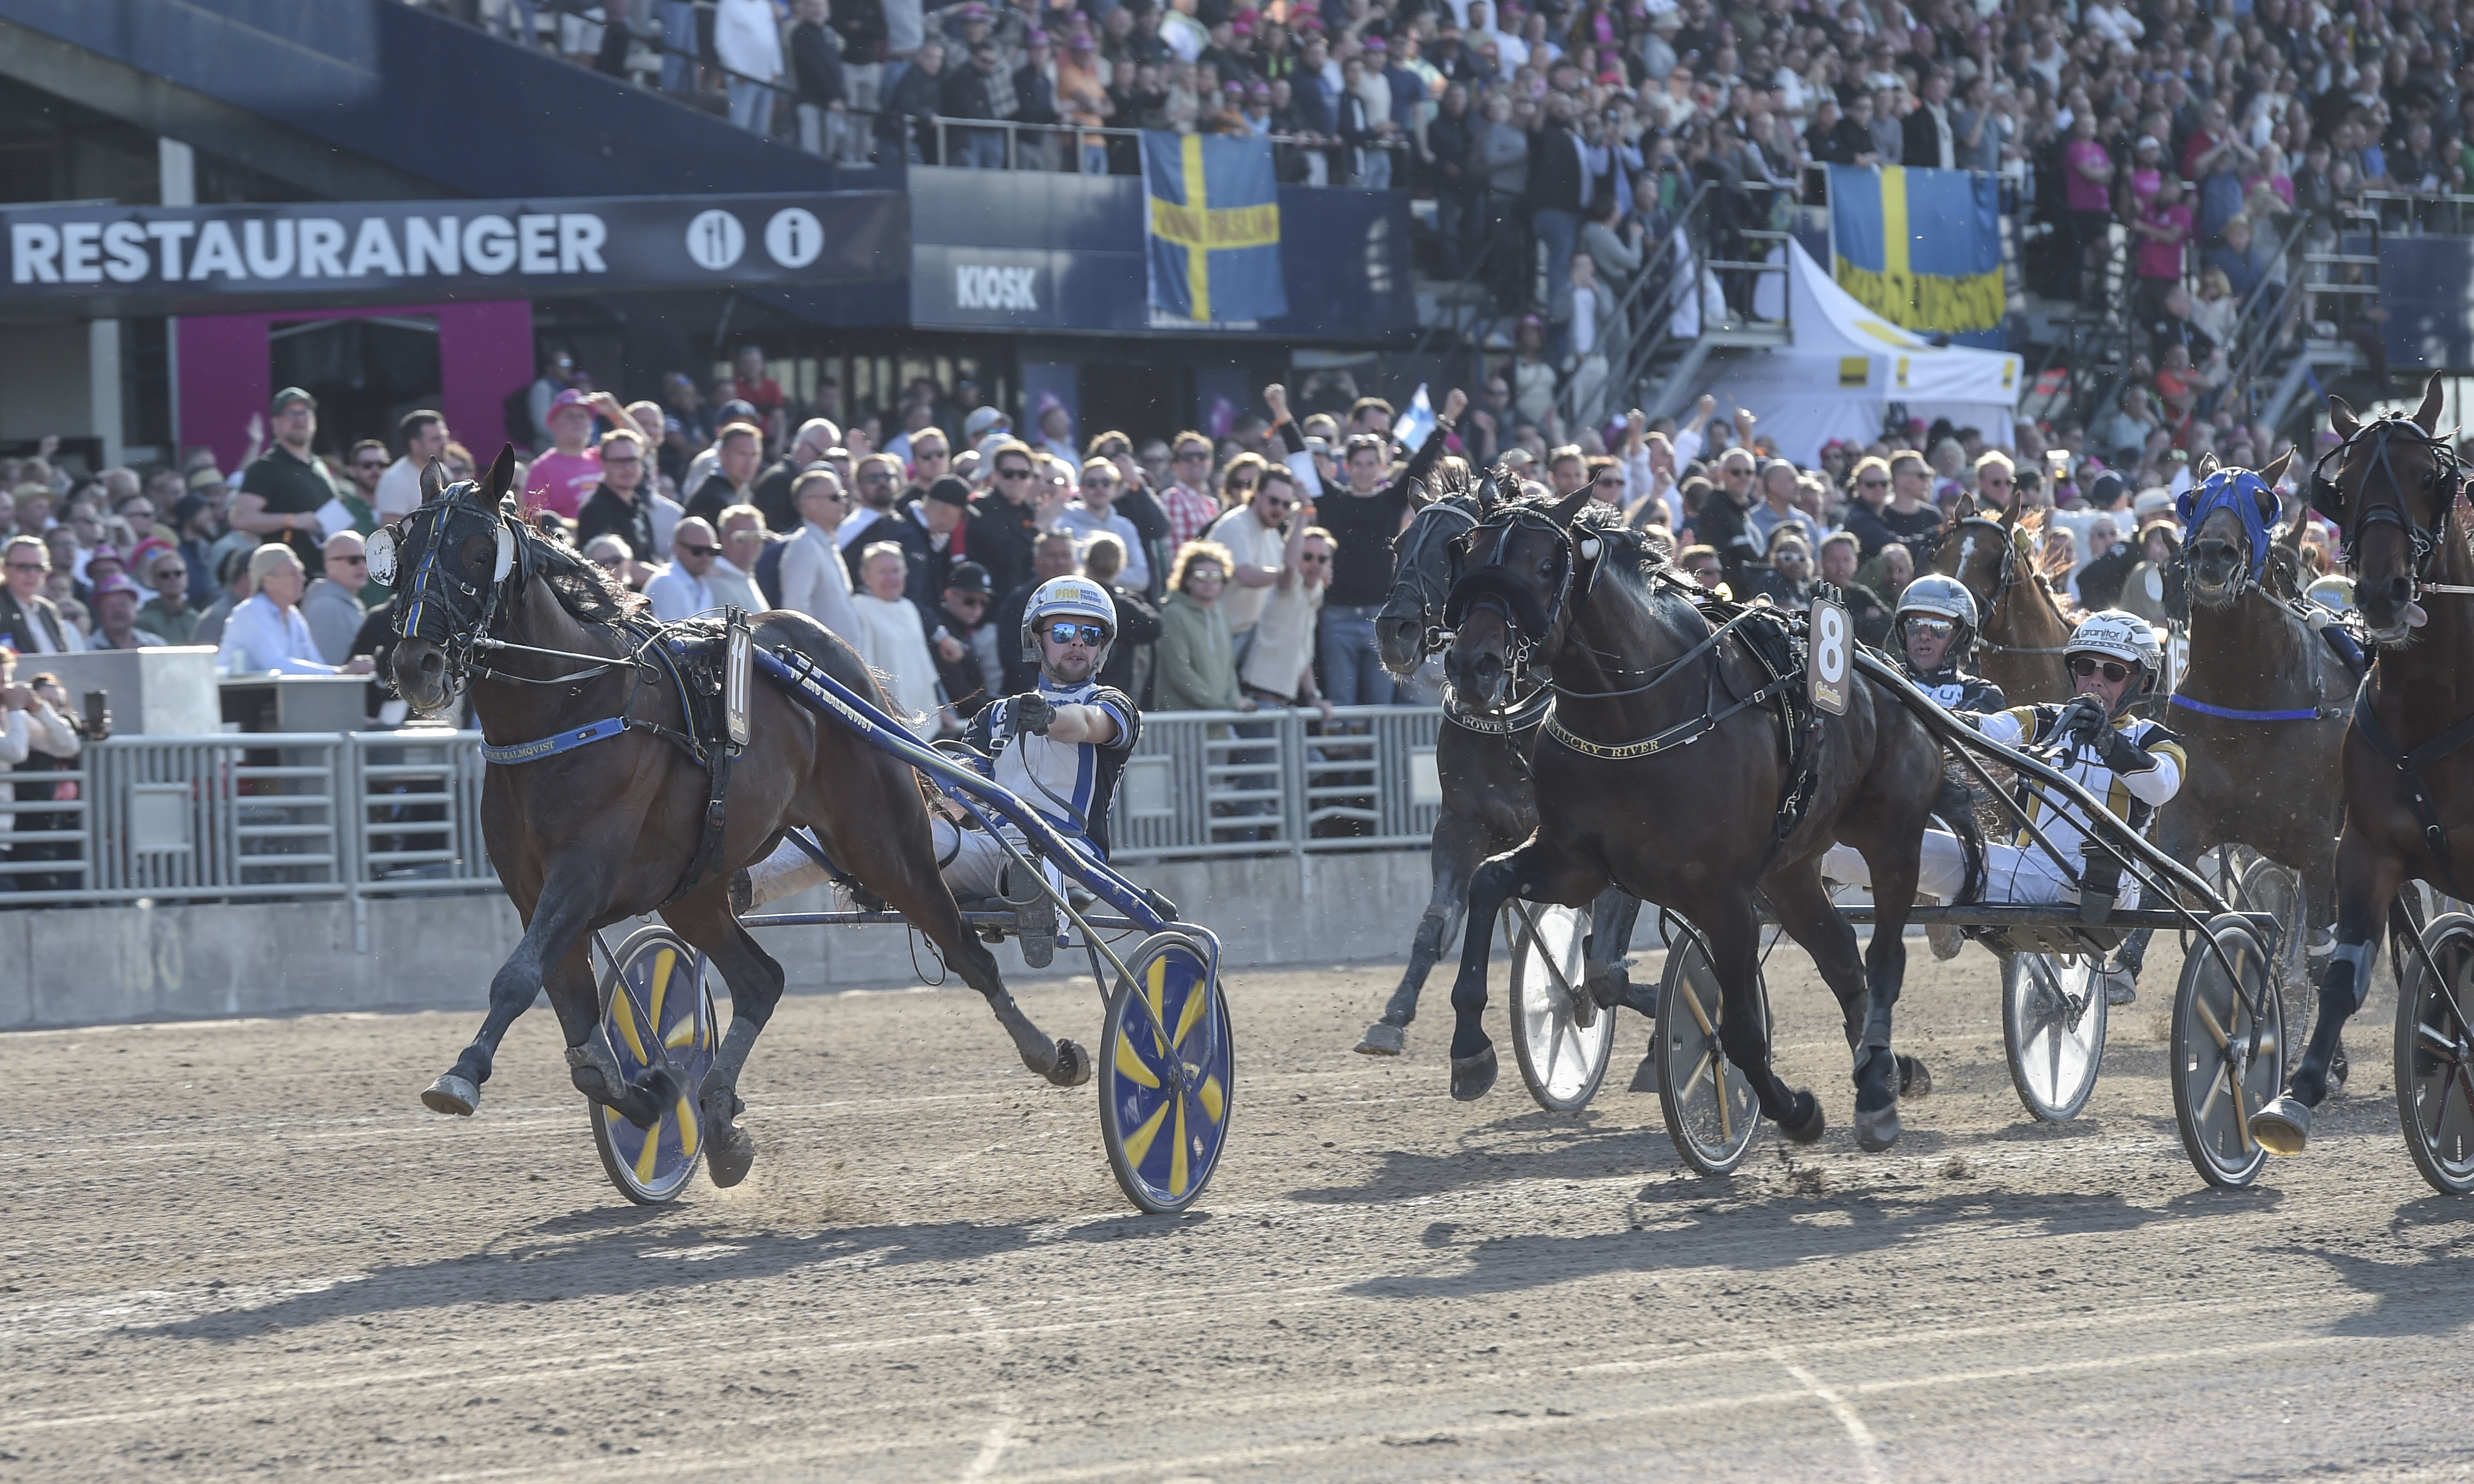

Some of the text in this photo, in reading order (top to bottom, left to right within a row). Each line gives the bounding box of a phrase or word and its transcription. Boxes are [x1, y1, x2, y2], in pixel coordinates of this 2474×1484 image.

[12, 214, 607, 283] RESTAURANGER
[957, 265, 1038, 311] KIOSK
[1055, 588, 1079, 599] PAN
[1080, 594, 1102, 603] TRADING
[2081, 629, 2121, 638] granitor
[1819, 607, 1844, 683] 8
[732, 632, 747, 713] 11
[790, 667, 821, 696] TOMAS
[822, 688, 874, 732] MALMQVIST
[1816, 681, 1841, 706] Solvalla
[1462, 715, 1515, 732] POWER
[502, 740, 554, 760] MALMQVIST
[1611, 740, 1660, 757] RIVER
